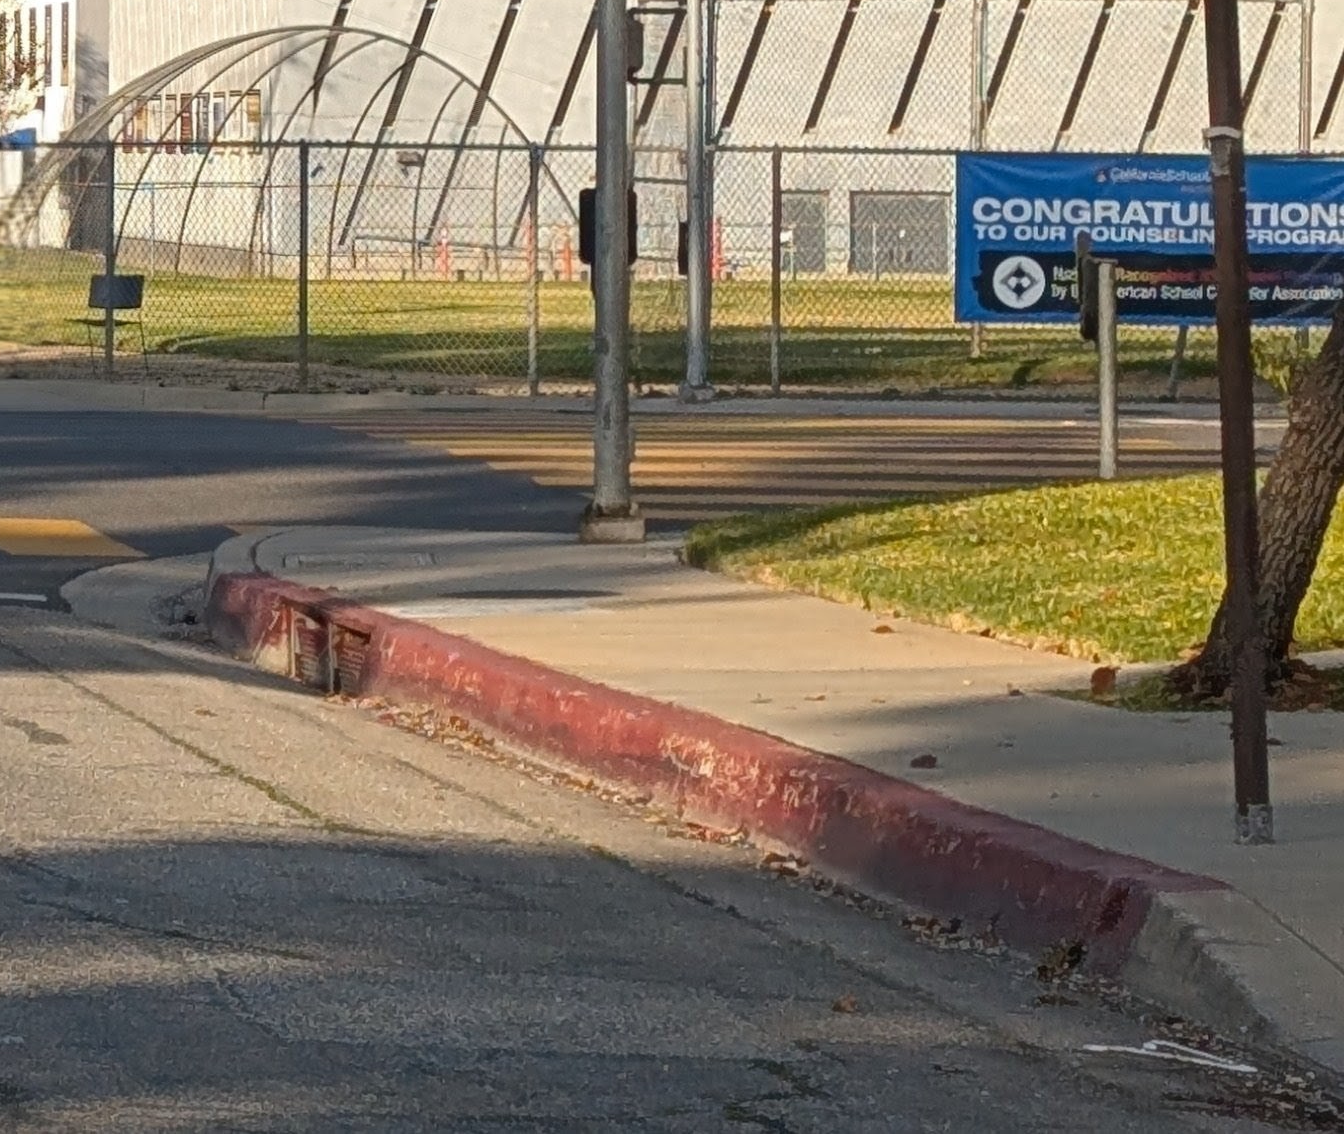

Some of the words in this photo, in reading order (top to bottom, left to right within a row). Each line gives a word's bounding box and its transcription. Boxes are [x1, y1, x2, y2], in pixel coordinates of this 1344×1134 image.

[972, 197, 1344, 228] CONGRATULTION
[974, 224, 1006, 241] TO
[1014, 225, 1065, 242] OUR
[1073, 225, 1216, 244] COUNSELIN
